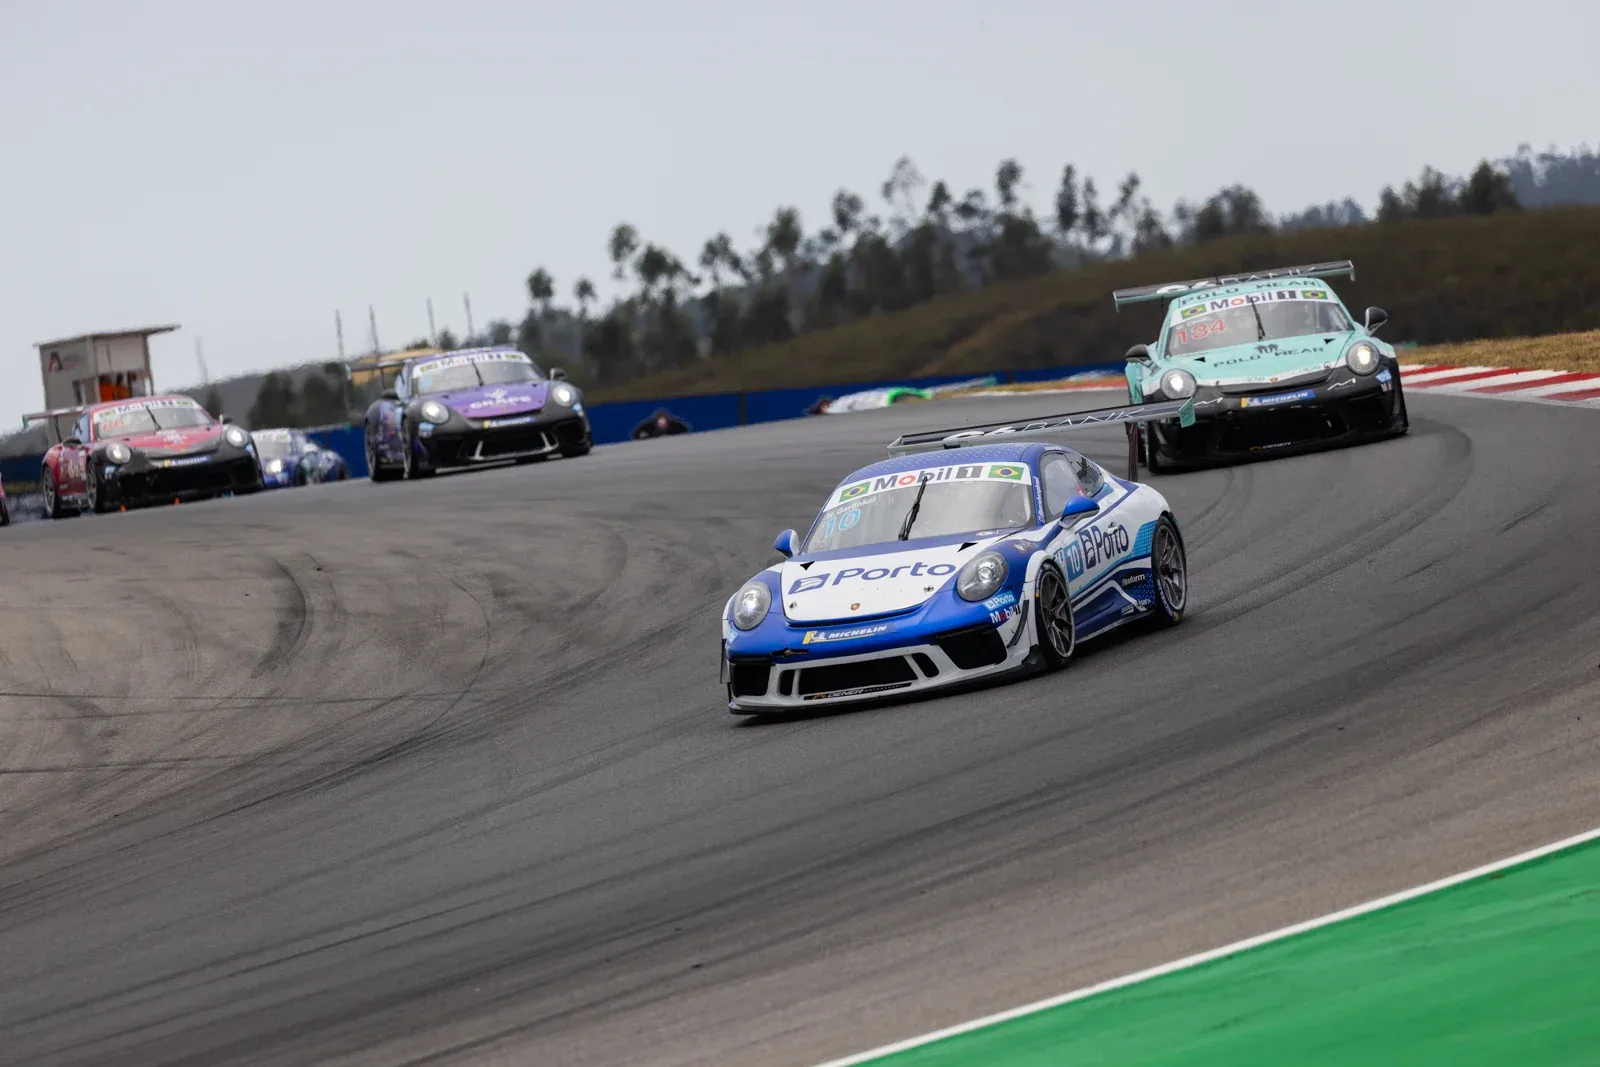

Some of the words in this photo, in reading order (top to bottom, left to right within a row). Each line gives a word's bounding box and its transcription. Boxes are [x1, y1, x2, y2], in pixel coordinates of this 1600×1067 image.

[1181, 287, 1239, 306] POLO
[1256, 280, 1317, 290] WEAR
[1210, 292, 1273, 311] Mobil
[1176, 319, 1227, 344] 134
[1213, 355, 1261, 367] POLO
[1274, 346, 1324, 357] WEAR
[1261, 391, 1309, 404] MICHELIN
[873, 467, 953, 492] Mobil
[823, 509, 862, 538] 10
[1067, 545, 1081, 575] 10
[1091, 524, 1129, 564] Porto
[832, 562, 957, 586] Porto
[993, 593, 1015, 608] Porto
[989, 605, 1016, 624] Mobil
[828, 625, 888, 639] MICHELIN
[827, 688, 864, 698] DENER
